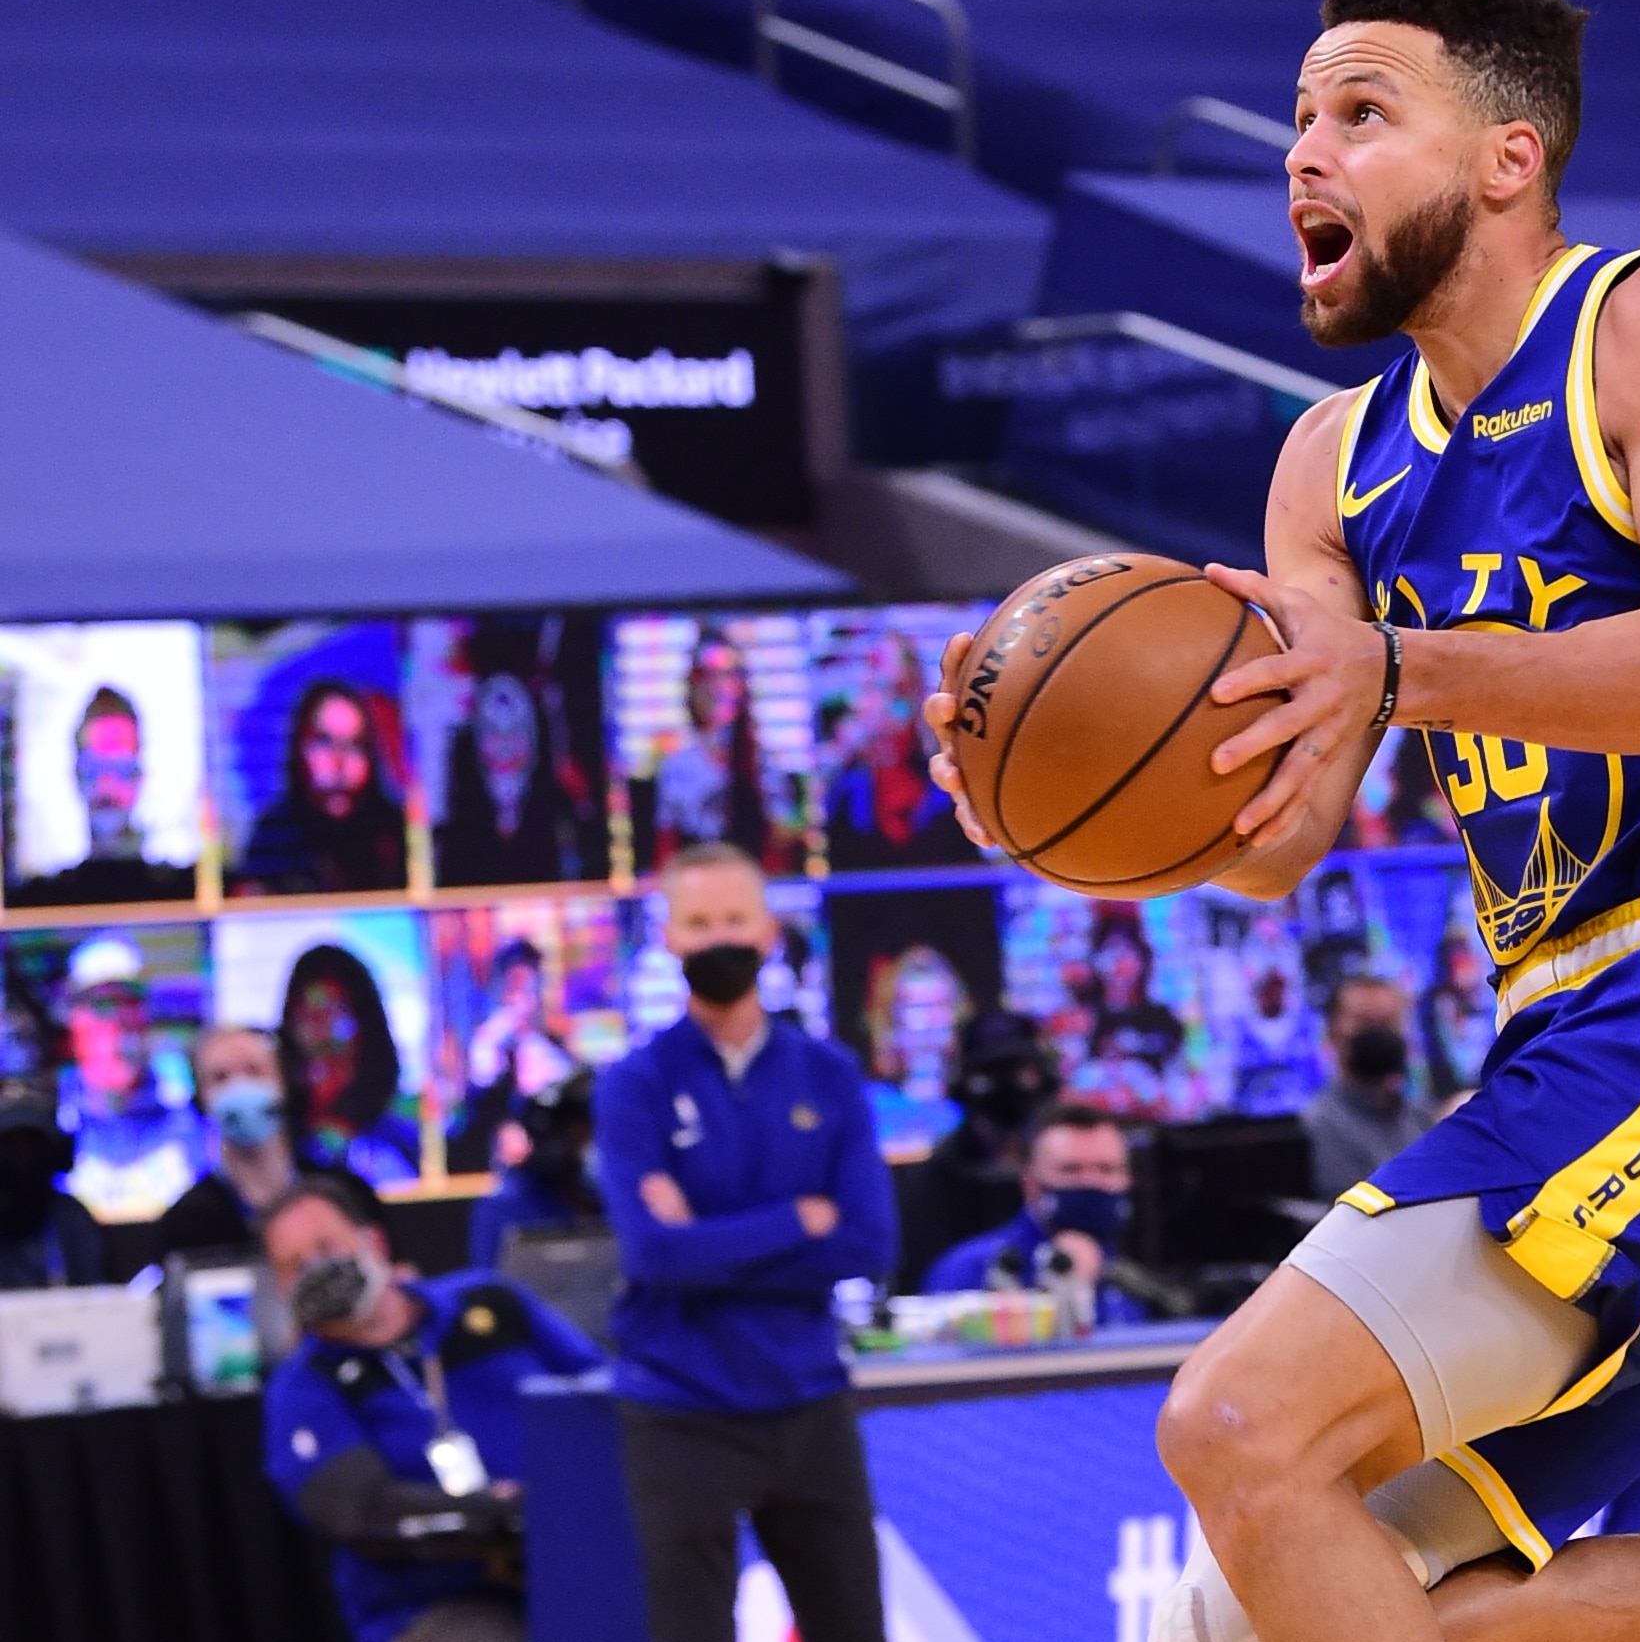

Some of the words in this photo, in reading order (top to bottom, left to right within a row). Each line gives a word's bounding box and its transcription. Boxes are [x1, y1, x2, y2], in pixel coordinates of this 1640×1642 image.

[1472, 400, 1553, 442] Rakuten
[1377, 692, 1395, 722] PLAY
[1447, 732, 1549, 817] 30
